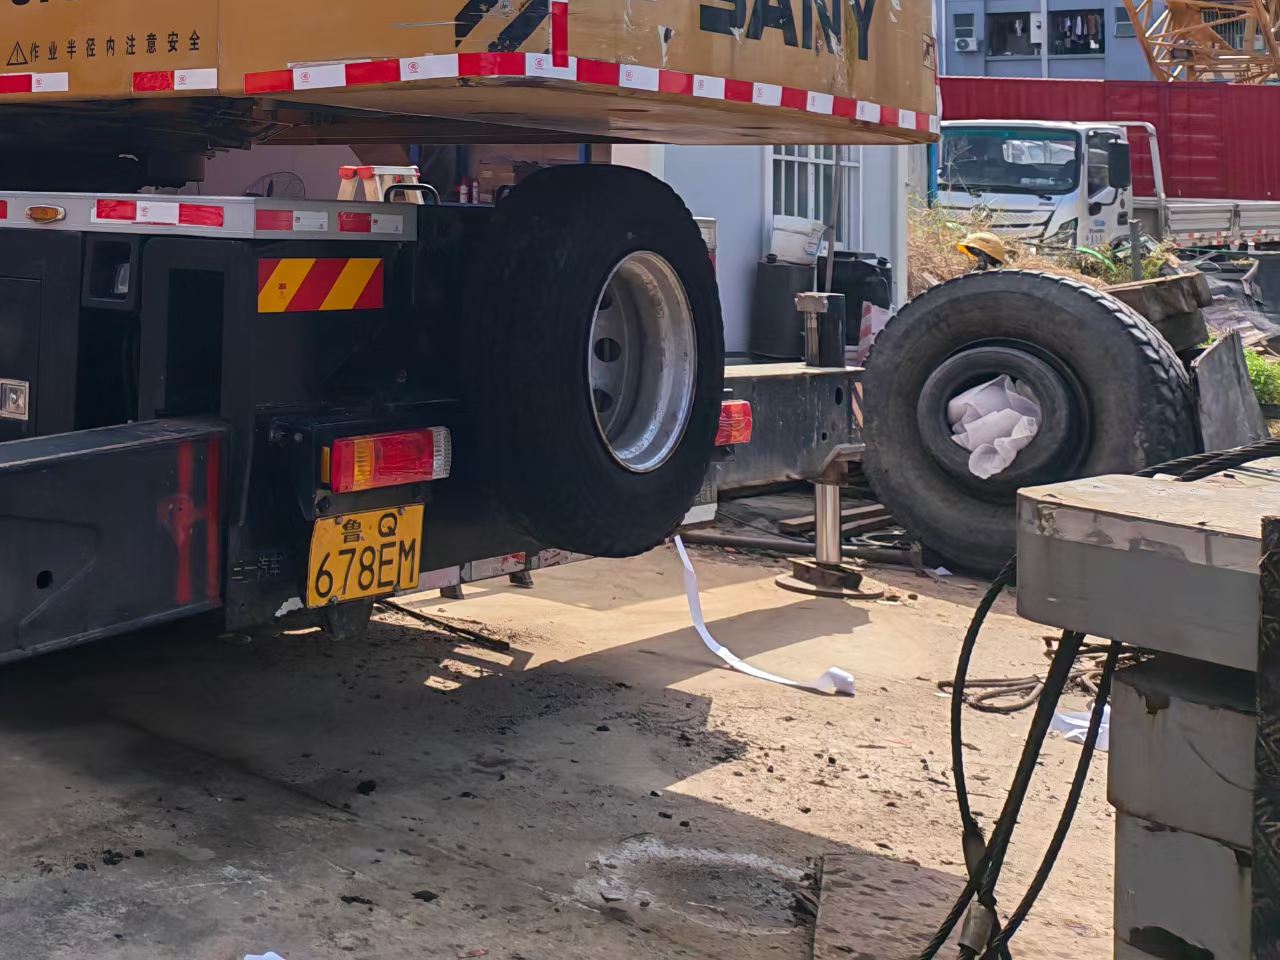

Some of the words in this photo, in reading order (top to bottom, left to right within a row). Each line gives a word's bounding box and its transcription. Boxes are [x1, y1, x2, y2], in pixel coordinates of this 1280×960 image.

[29, 29, 201, 63] 作业半径内注意安全
[315, 538, 417, 598] 678EM
